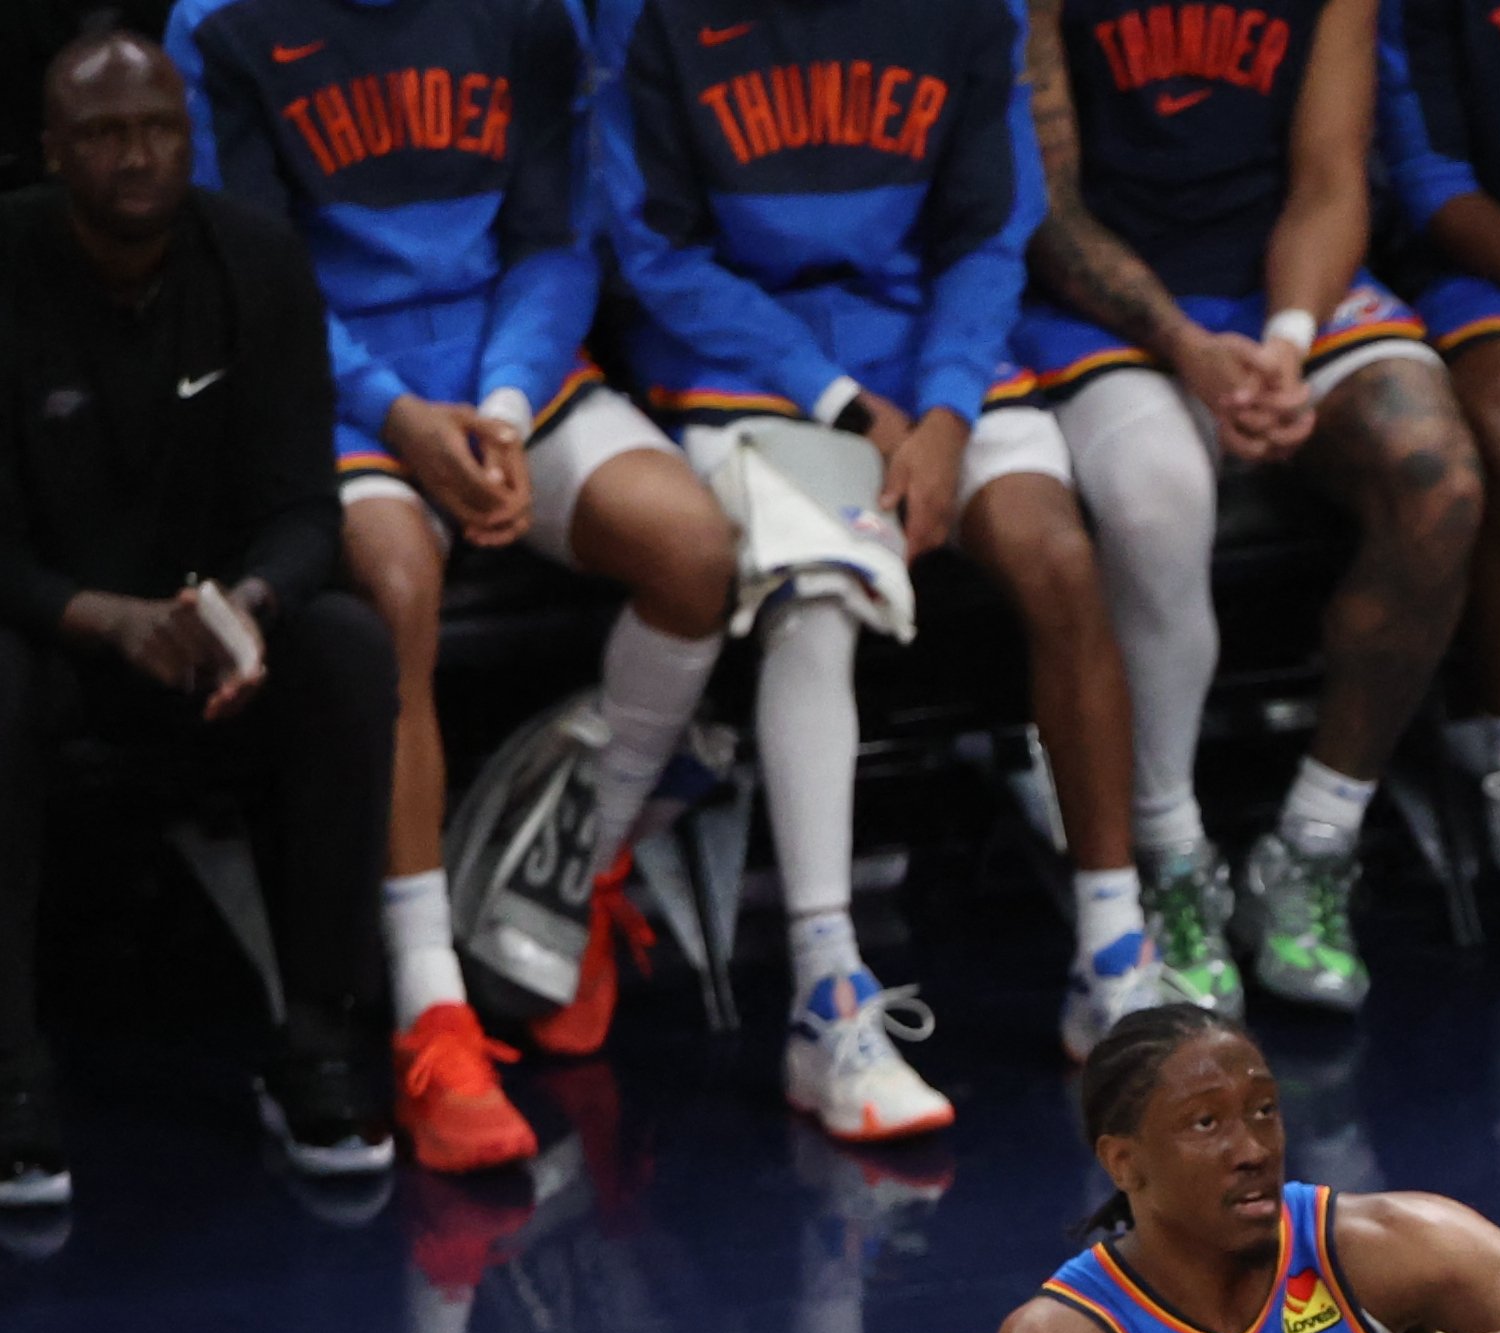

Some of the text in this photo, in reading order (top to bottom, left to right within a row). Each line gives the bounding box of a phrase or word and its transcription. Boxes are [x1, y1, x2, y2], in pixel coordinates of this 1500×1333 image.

[1095, 4, 1291, 96] THUNDER
[281, 67, 512, 176] THUNDER
[698, 59, 947, 165] THUNDER
